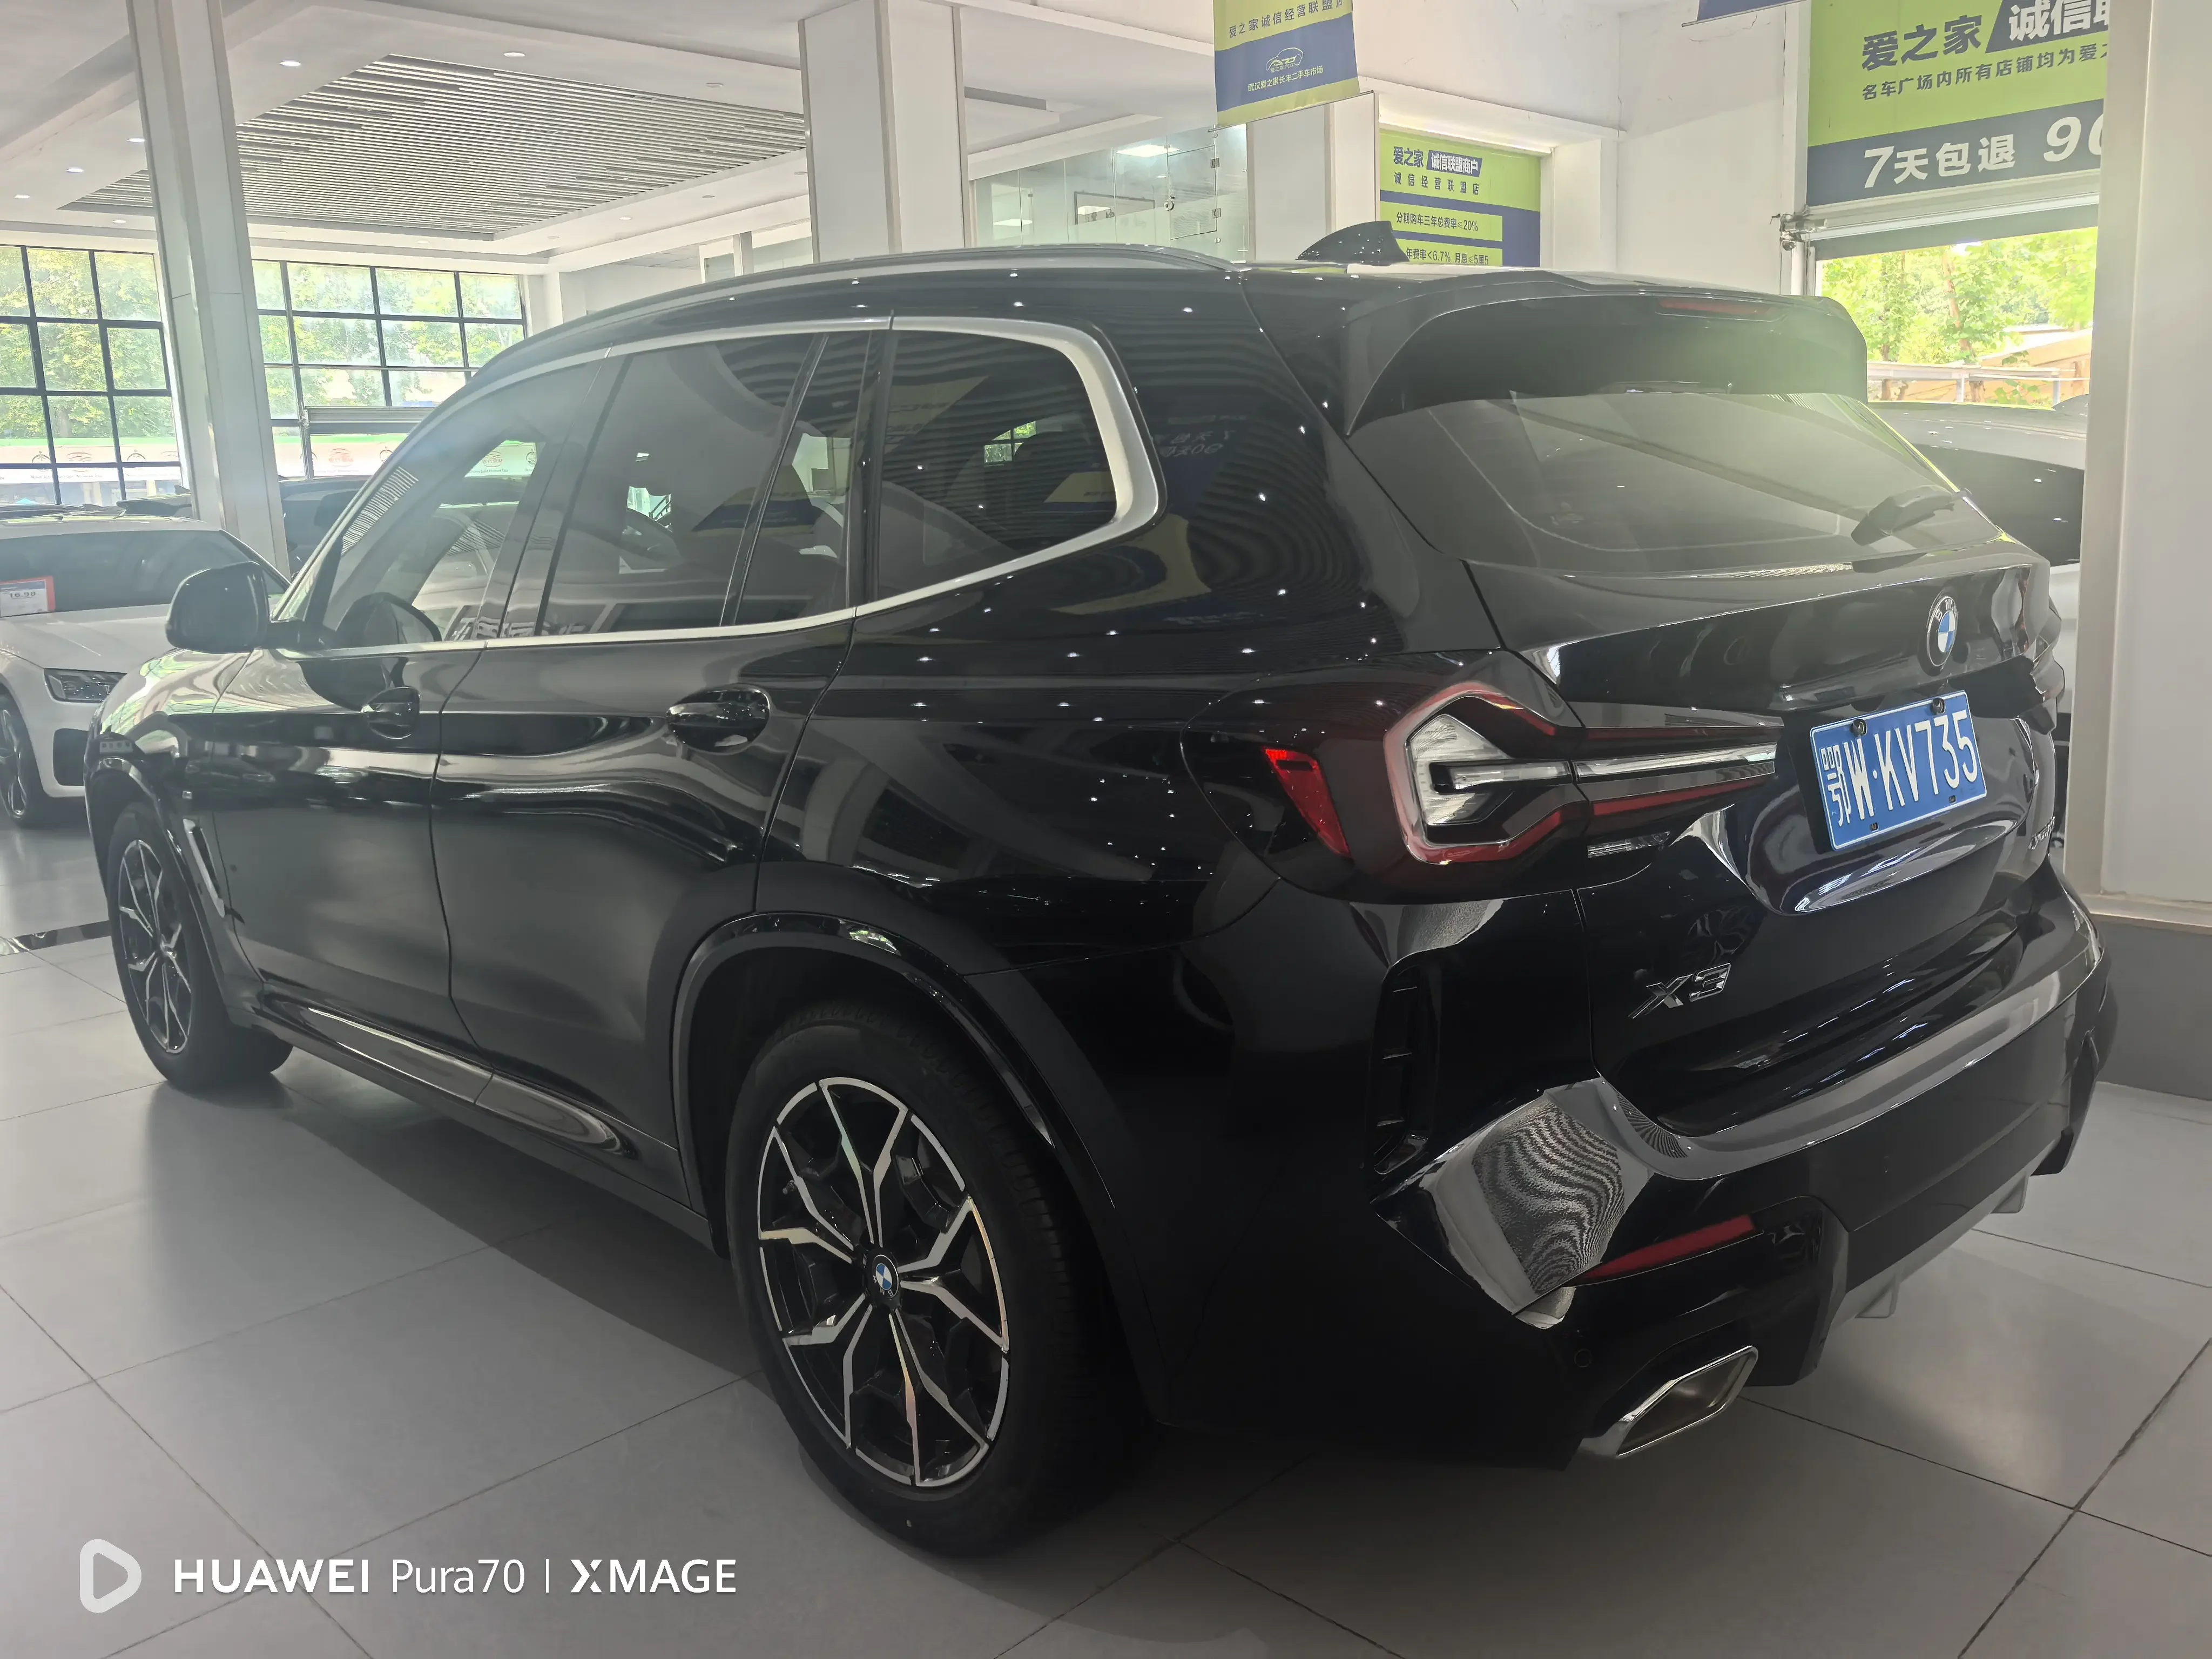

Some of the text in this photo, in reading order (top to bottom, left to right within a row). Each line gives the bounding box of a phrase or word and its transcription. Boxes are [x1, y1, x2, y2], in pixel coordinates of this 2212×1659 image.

[1862, 15, 1982, 71] 爱之家
[1393, 146, 1478, 174] 爱之家 诚信联盟商户
[1394, 171, 1479, 195] 诚信经营联盟店
[1864, 134, 2015, 188] 7天包退
[1628, 962, 1731, 1019] X3
